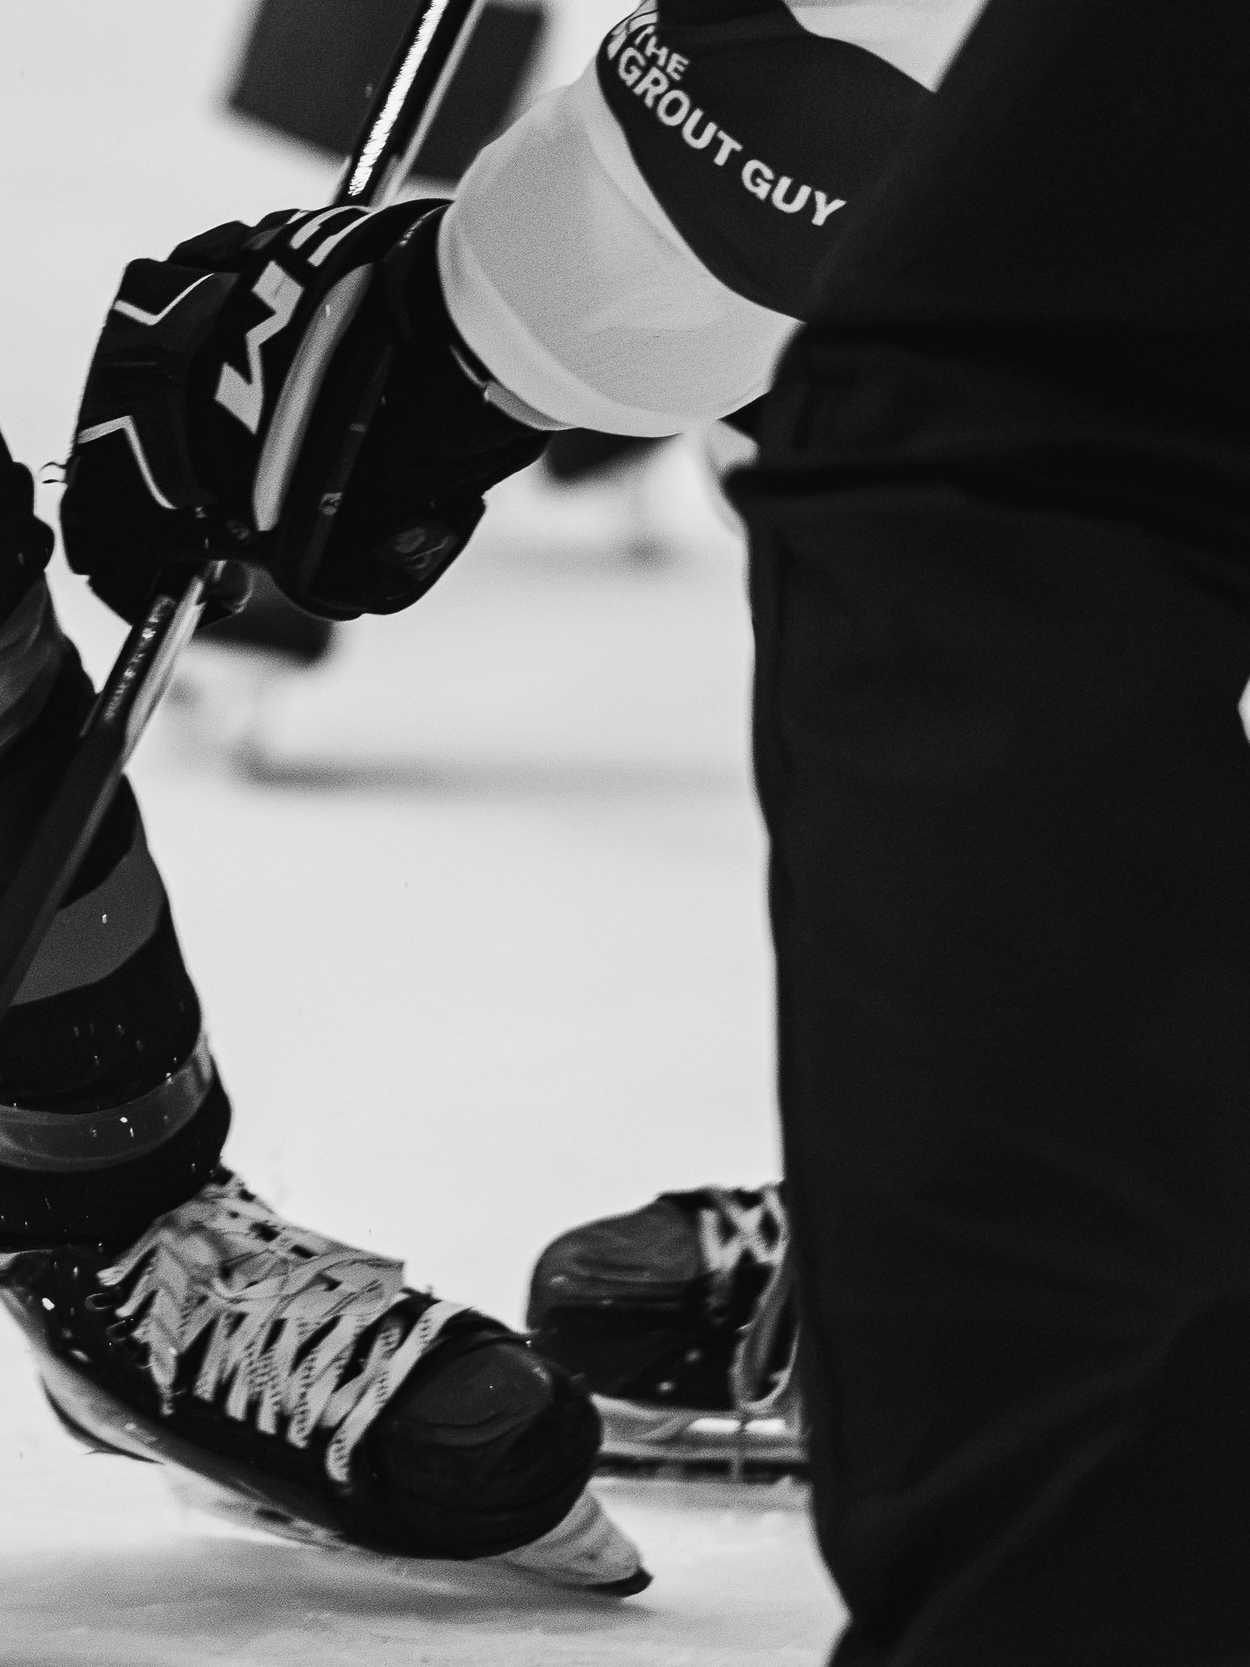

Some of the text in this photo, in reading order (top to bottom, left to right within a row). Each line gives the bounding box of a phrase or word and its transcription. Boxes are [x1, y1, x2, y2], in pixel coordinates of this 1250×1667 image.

[633, 25, 690, 81] THE
[618, 47, 847, 226] GROUT GUY
